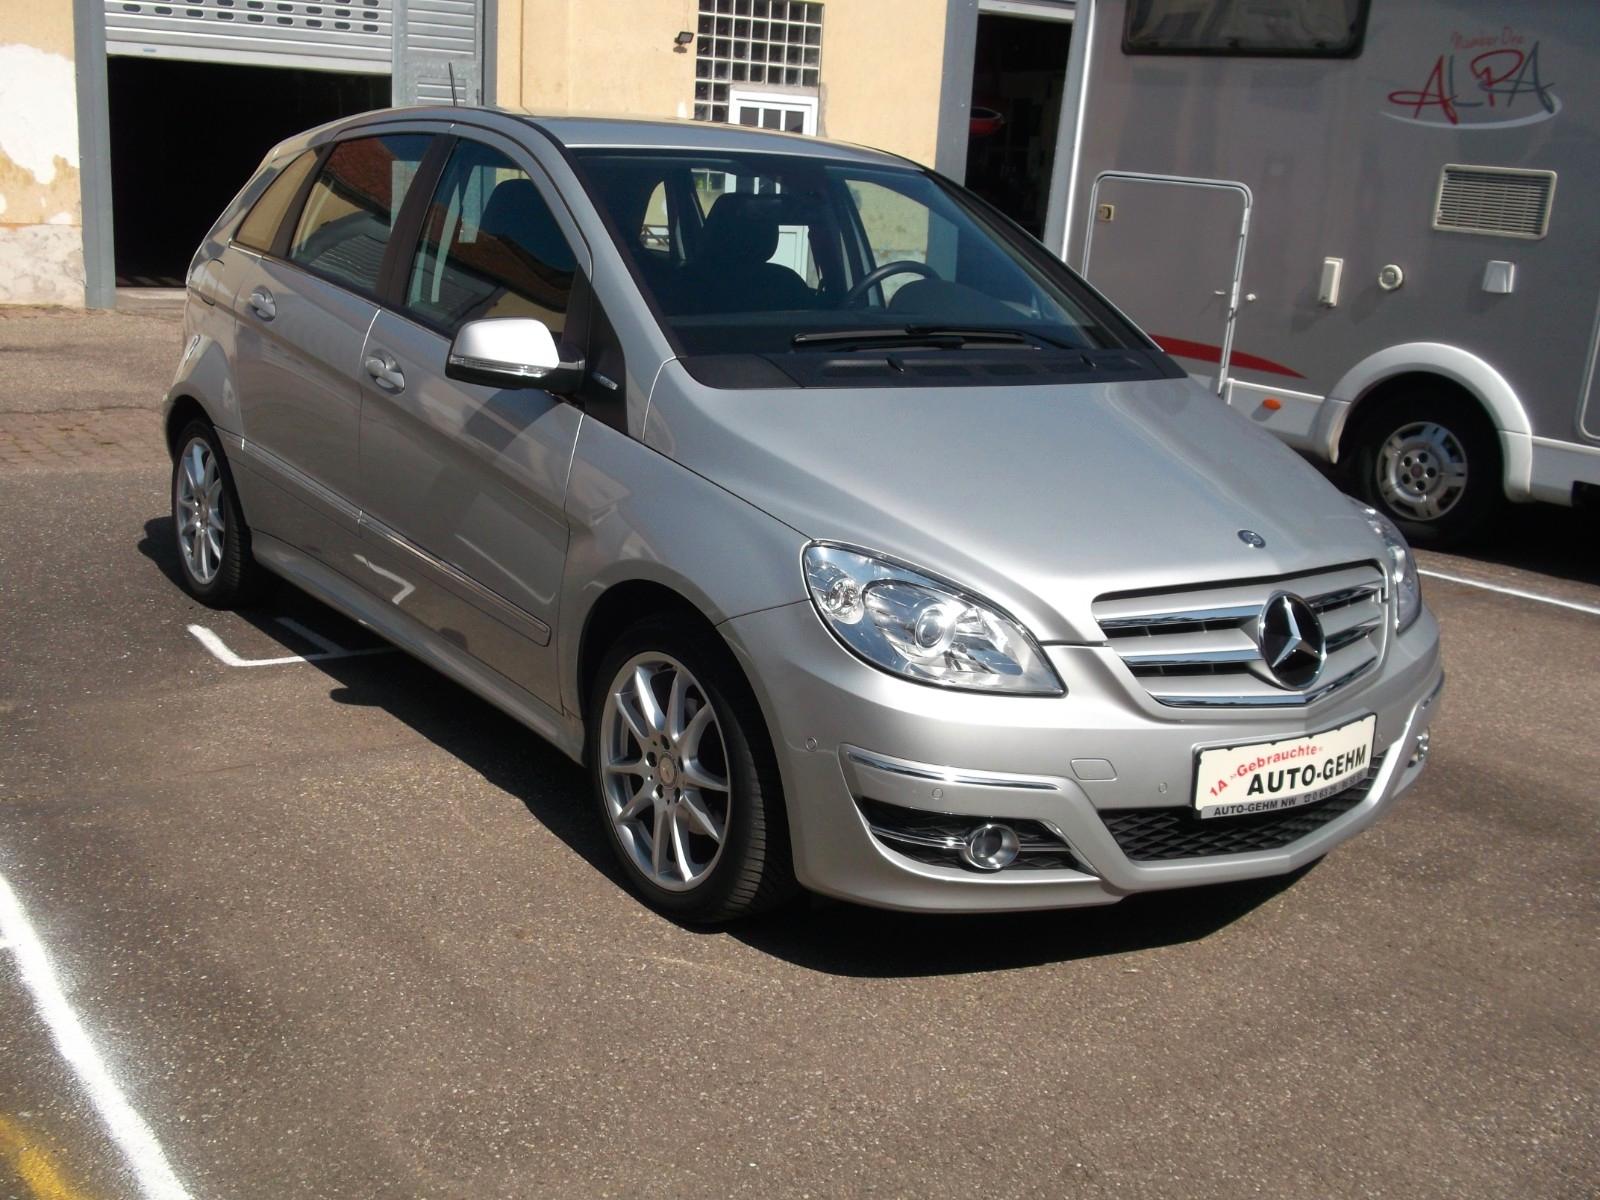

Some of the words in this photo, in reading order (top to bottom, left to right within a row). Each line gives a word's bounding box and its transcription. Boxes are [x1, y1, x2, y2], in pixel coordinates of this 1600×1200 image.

[1387, 40, 1555, 124] ALPA
[1246, 743, 1367, 796] AUTO-GEHM
[1209, 779, 1228, 798] 1A
[1213, 800, 1278, 816] AUTO-GEHM
[1280, 797, 1297, 808] NW
